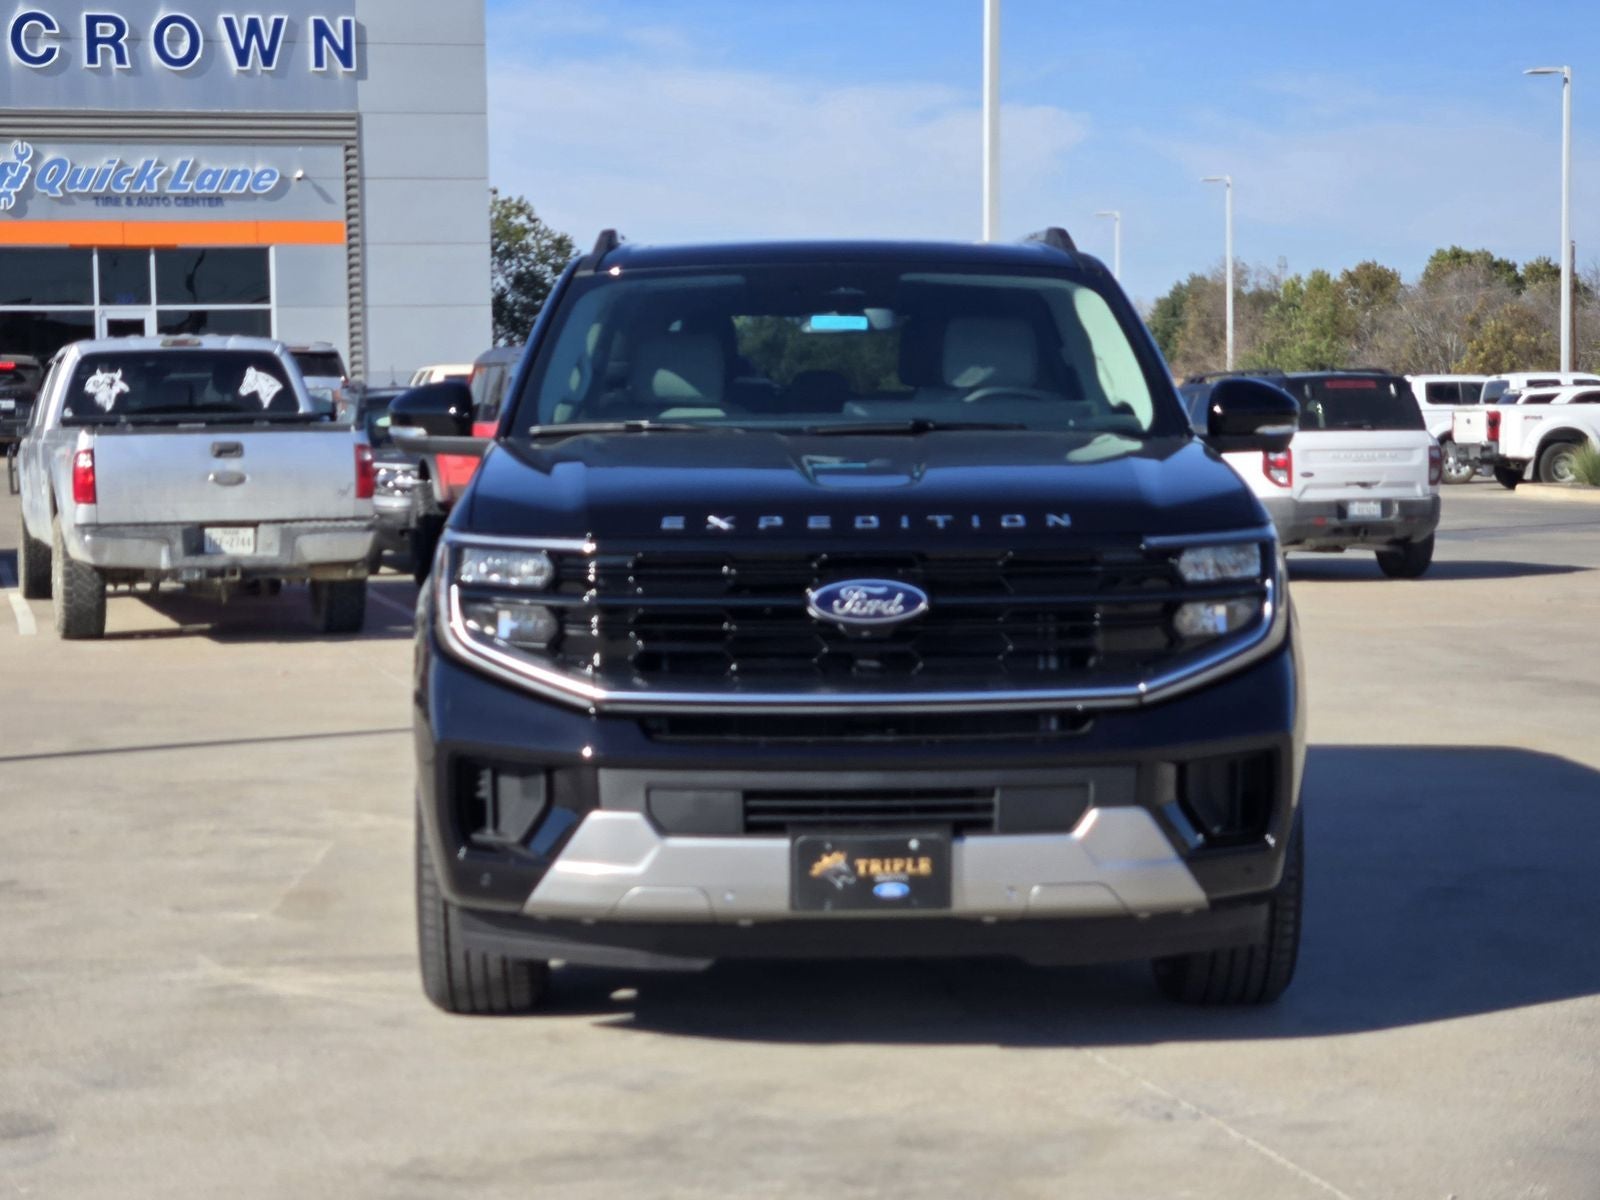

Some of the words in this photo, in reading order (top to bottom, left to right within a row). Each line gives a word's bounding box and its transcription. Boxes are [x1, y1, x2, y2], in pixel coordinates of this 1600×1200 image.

[8, 9, 357, 71] CROWN
[34, 156, 165, 198] Quick
[164, 158, 280, 194] Lane
[93, 196, 122, 208] TIRE
[125, 196, 134, 208] &
[136, 196, 171, 208] AUTO
[174, 196, 225, 208] CENTER
[660, 514, 1072, 531] EXPEDITION
[833, 585, 905, 615] Ford
[854, 856, 932, 877] TRIPLE
